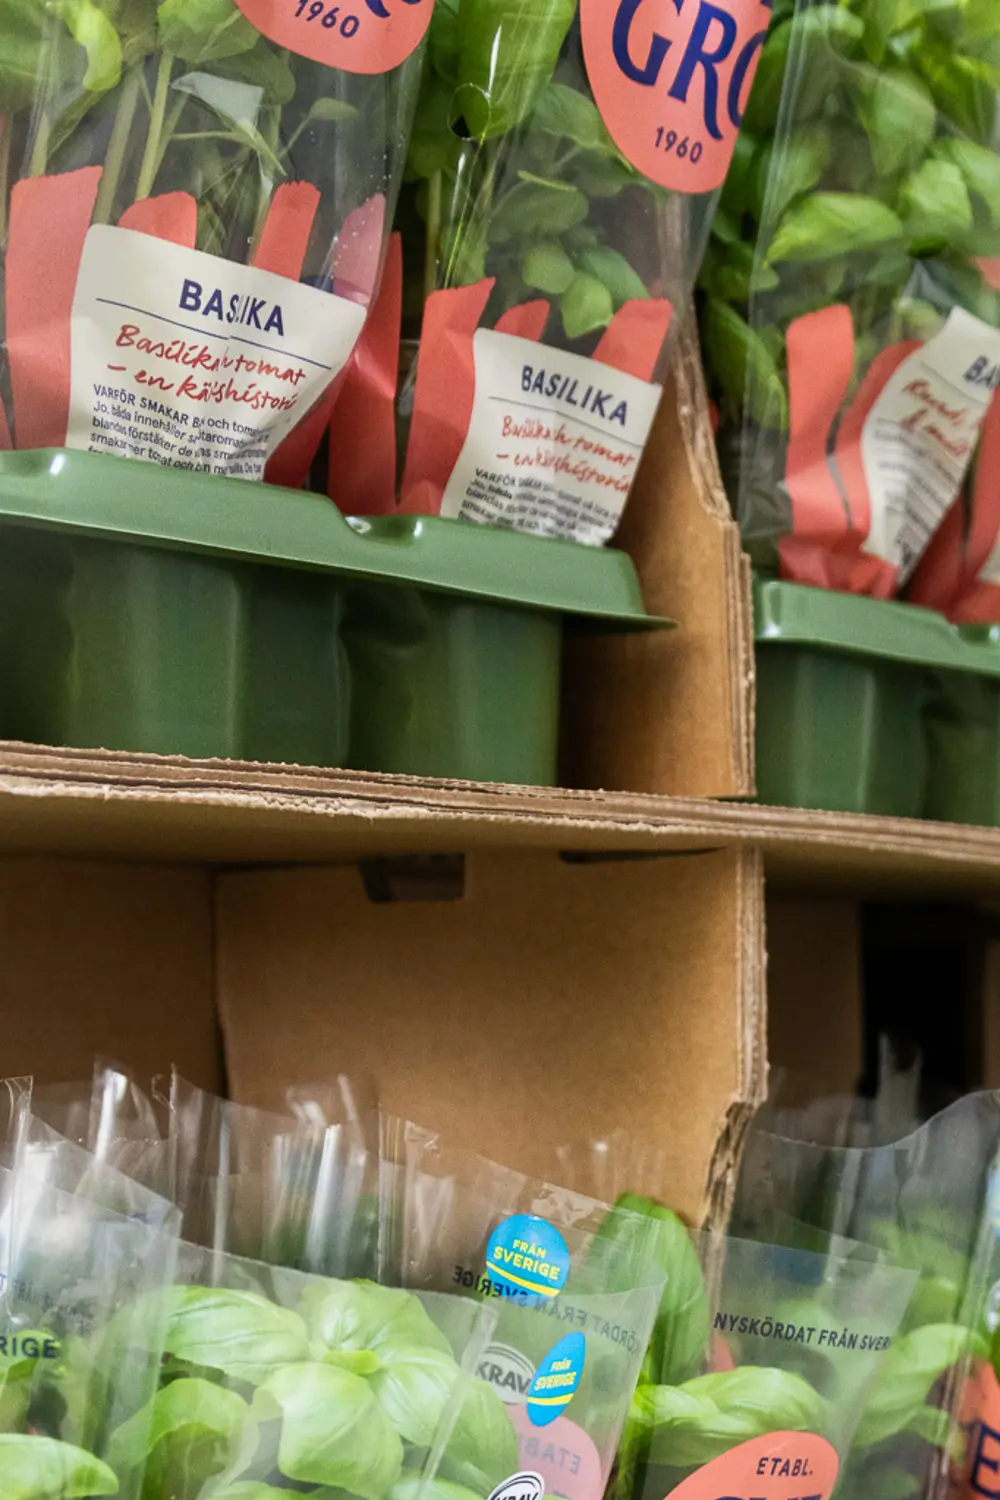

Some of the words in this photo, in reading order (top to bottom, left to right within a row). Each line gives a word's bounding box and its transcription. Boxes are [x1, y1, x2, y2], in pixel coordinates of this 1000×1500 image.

[295, 0, 359, 38] 1960
[655, 126, 703, 164] 1960
[93, 384, 136, 406] VARFÖR
[140, 396, 189, 424] SMAKAR
[521, 365, 628, 427] BASILIKA
[493, 1246, 561, 1280] SVERIGE
[513, 1239, 547, 1258] FRÅN
[714, 1312, 815, 1344] NYSKÖRDAT
[818, 1328, 858, 1349] FRÅN
[756, 1457, 814, 1477] ETABL.
